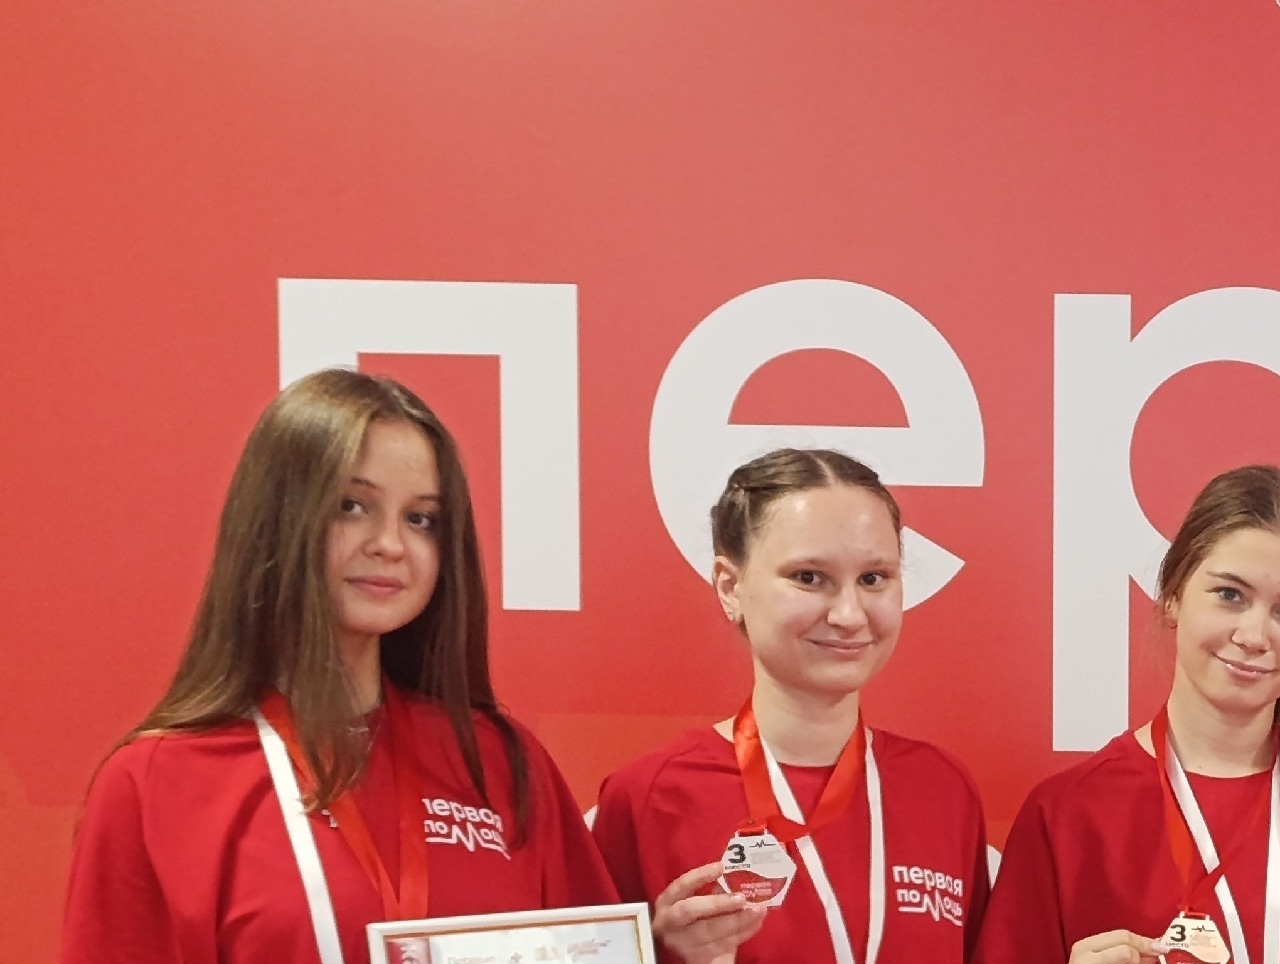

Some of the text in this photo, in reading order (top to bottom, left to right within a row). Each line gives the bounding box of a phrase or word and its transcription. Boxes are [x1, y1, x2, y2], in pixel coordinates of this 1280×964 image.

[727, 843, 747, 864] 3
[892, 865, 963, 897] первая
[1169, 924, 1187, 943] 3
